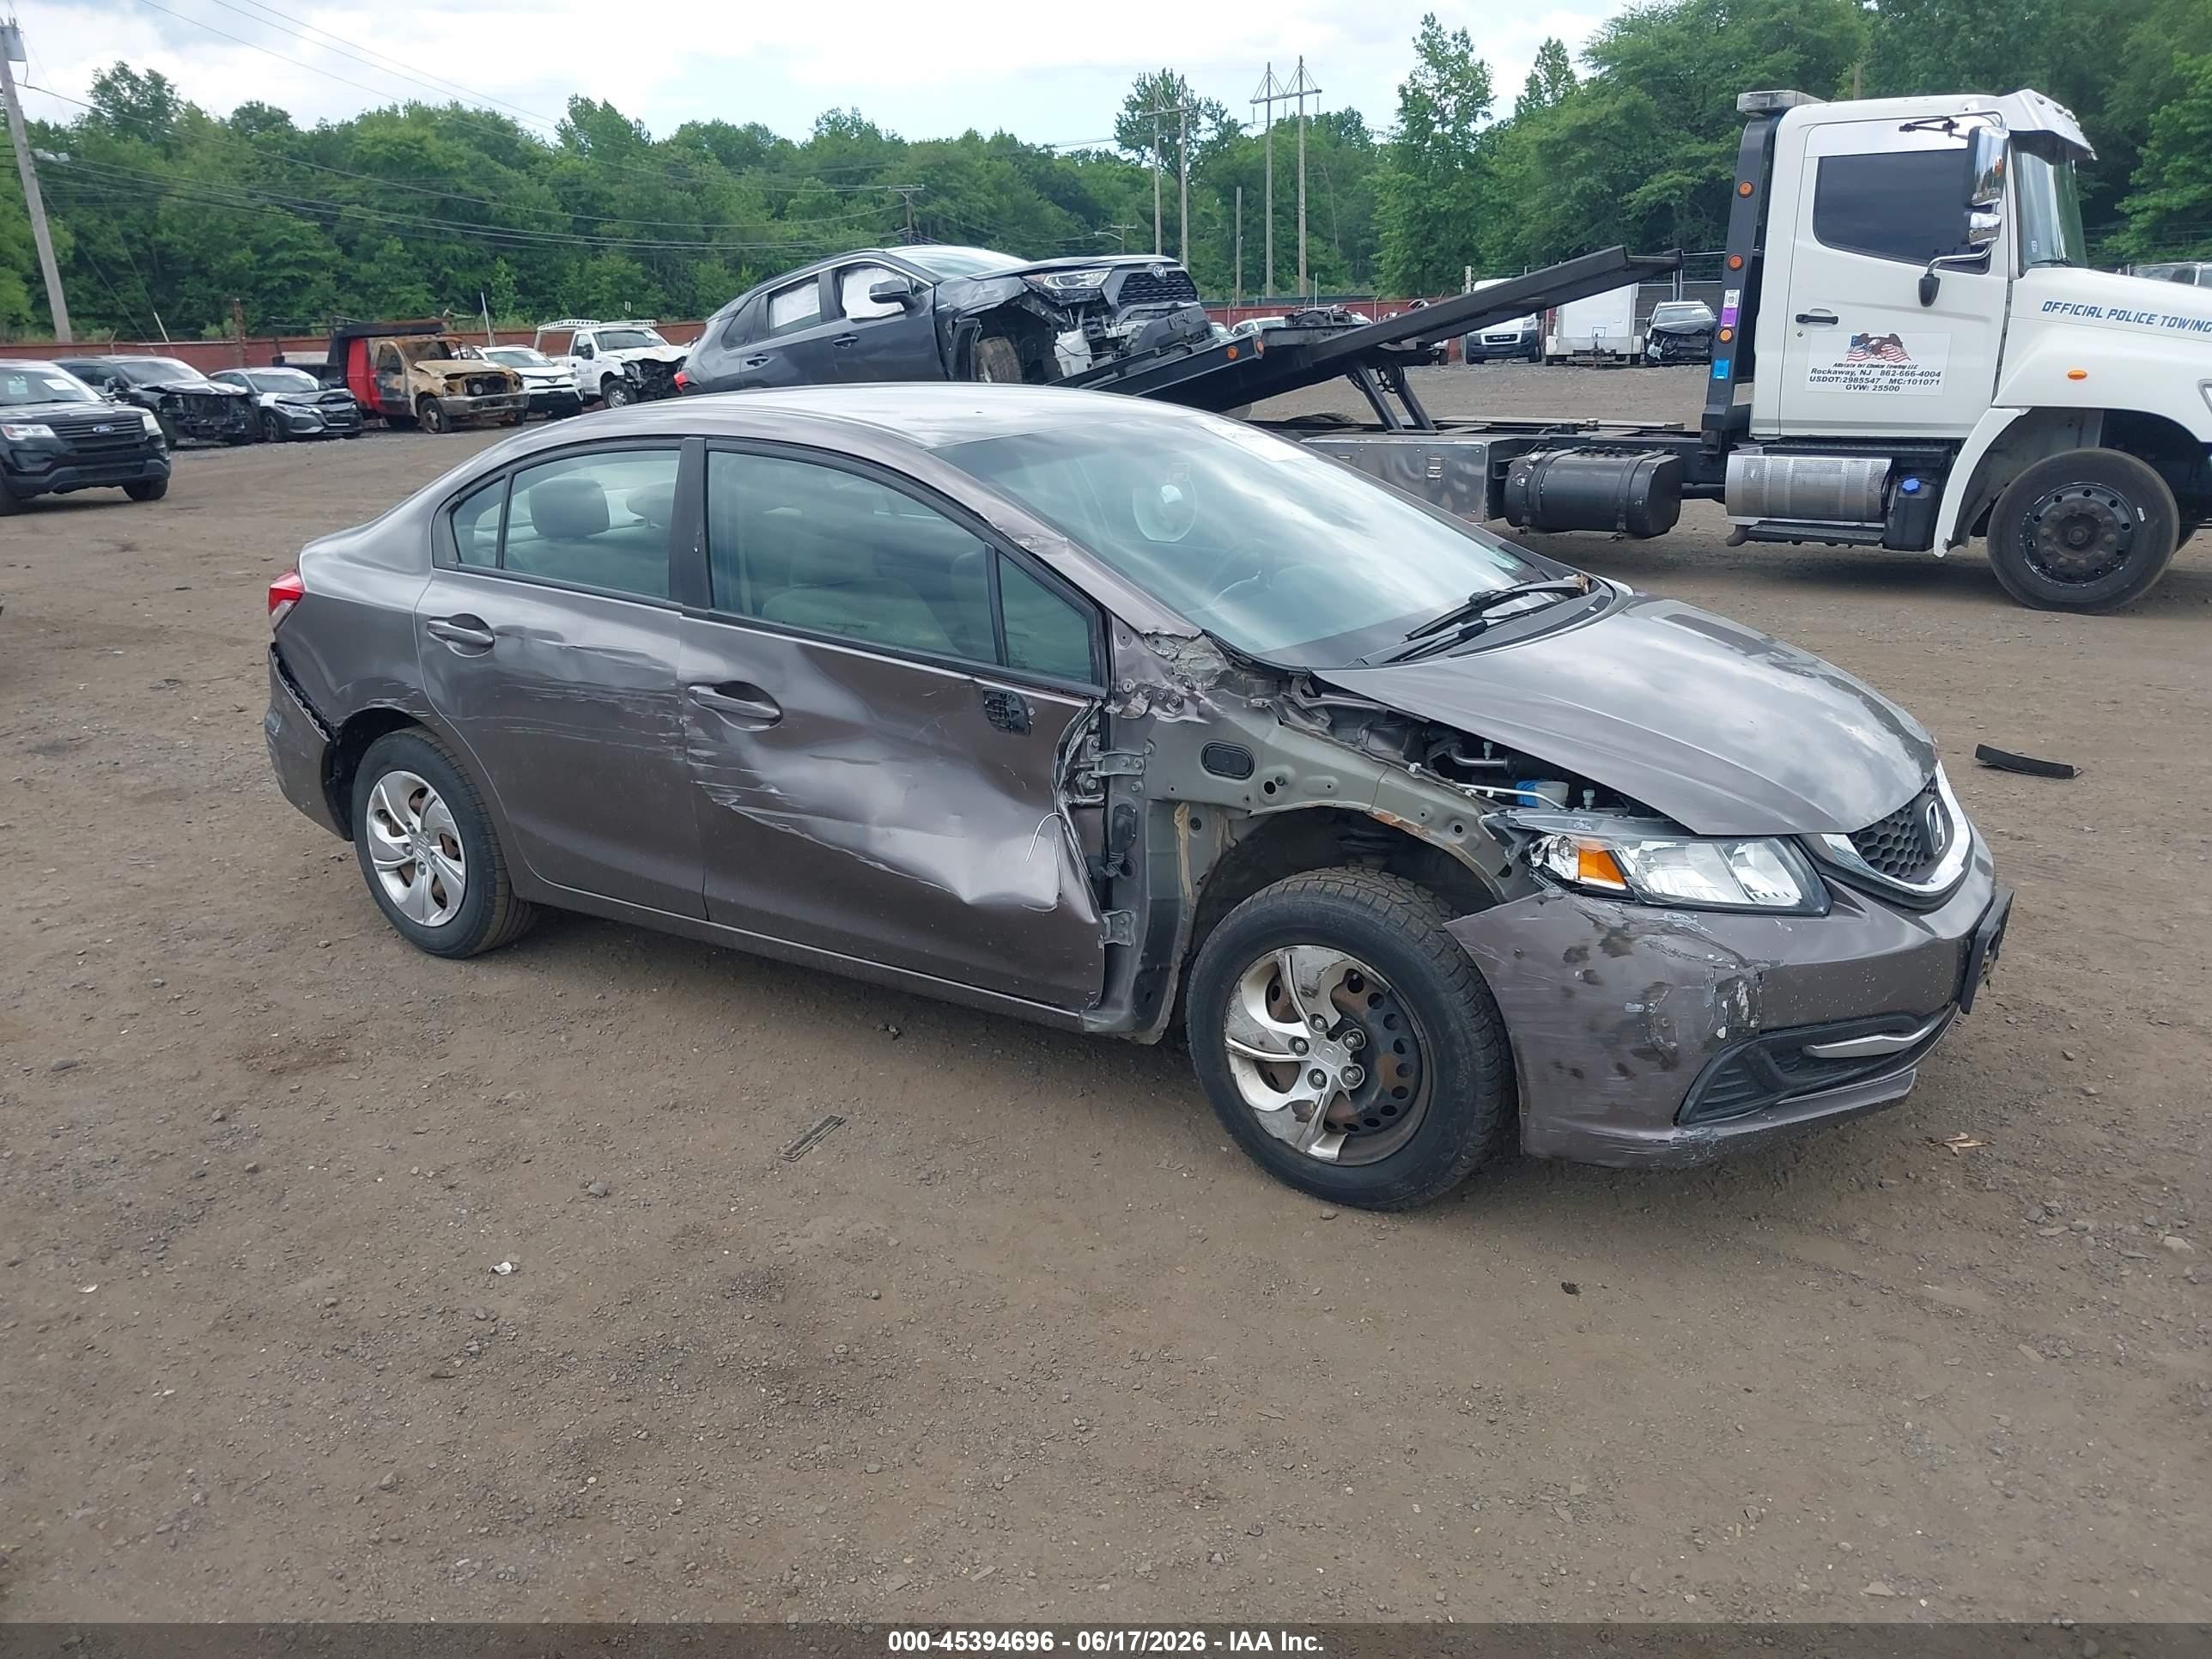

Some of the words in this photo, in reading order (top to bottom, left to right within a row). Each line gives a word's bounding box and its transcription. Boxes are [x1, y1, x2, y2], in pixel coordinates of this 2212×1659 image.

[2041, 301, 2103, 319] OFFICIAL
[2106, 308, 2158, 325] POLICE
[2160, 315, 2212, 333] TOWING
[1810, 368, 1856, 377] Rockaway,
[1880, 369, 1942, 378] 862-666-4004
[1808, 375, 1881, 384] USDOT:2985547
